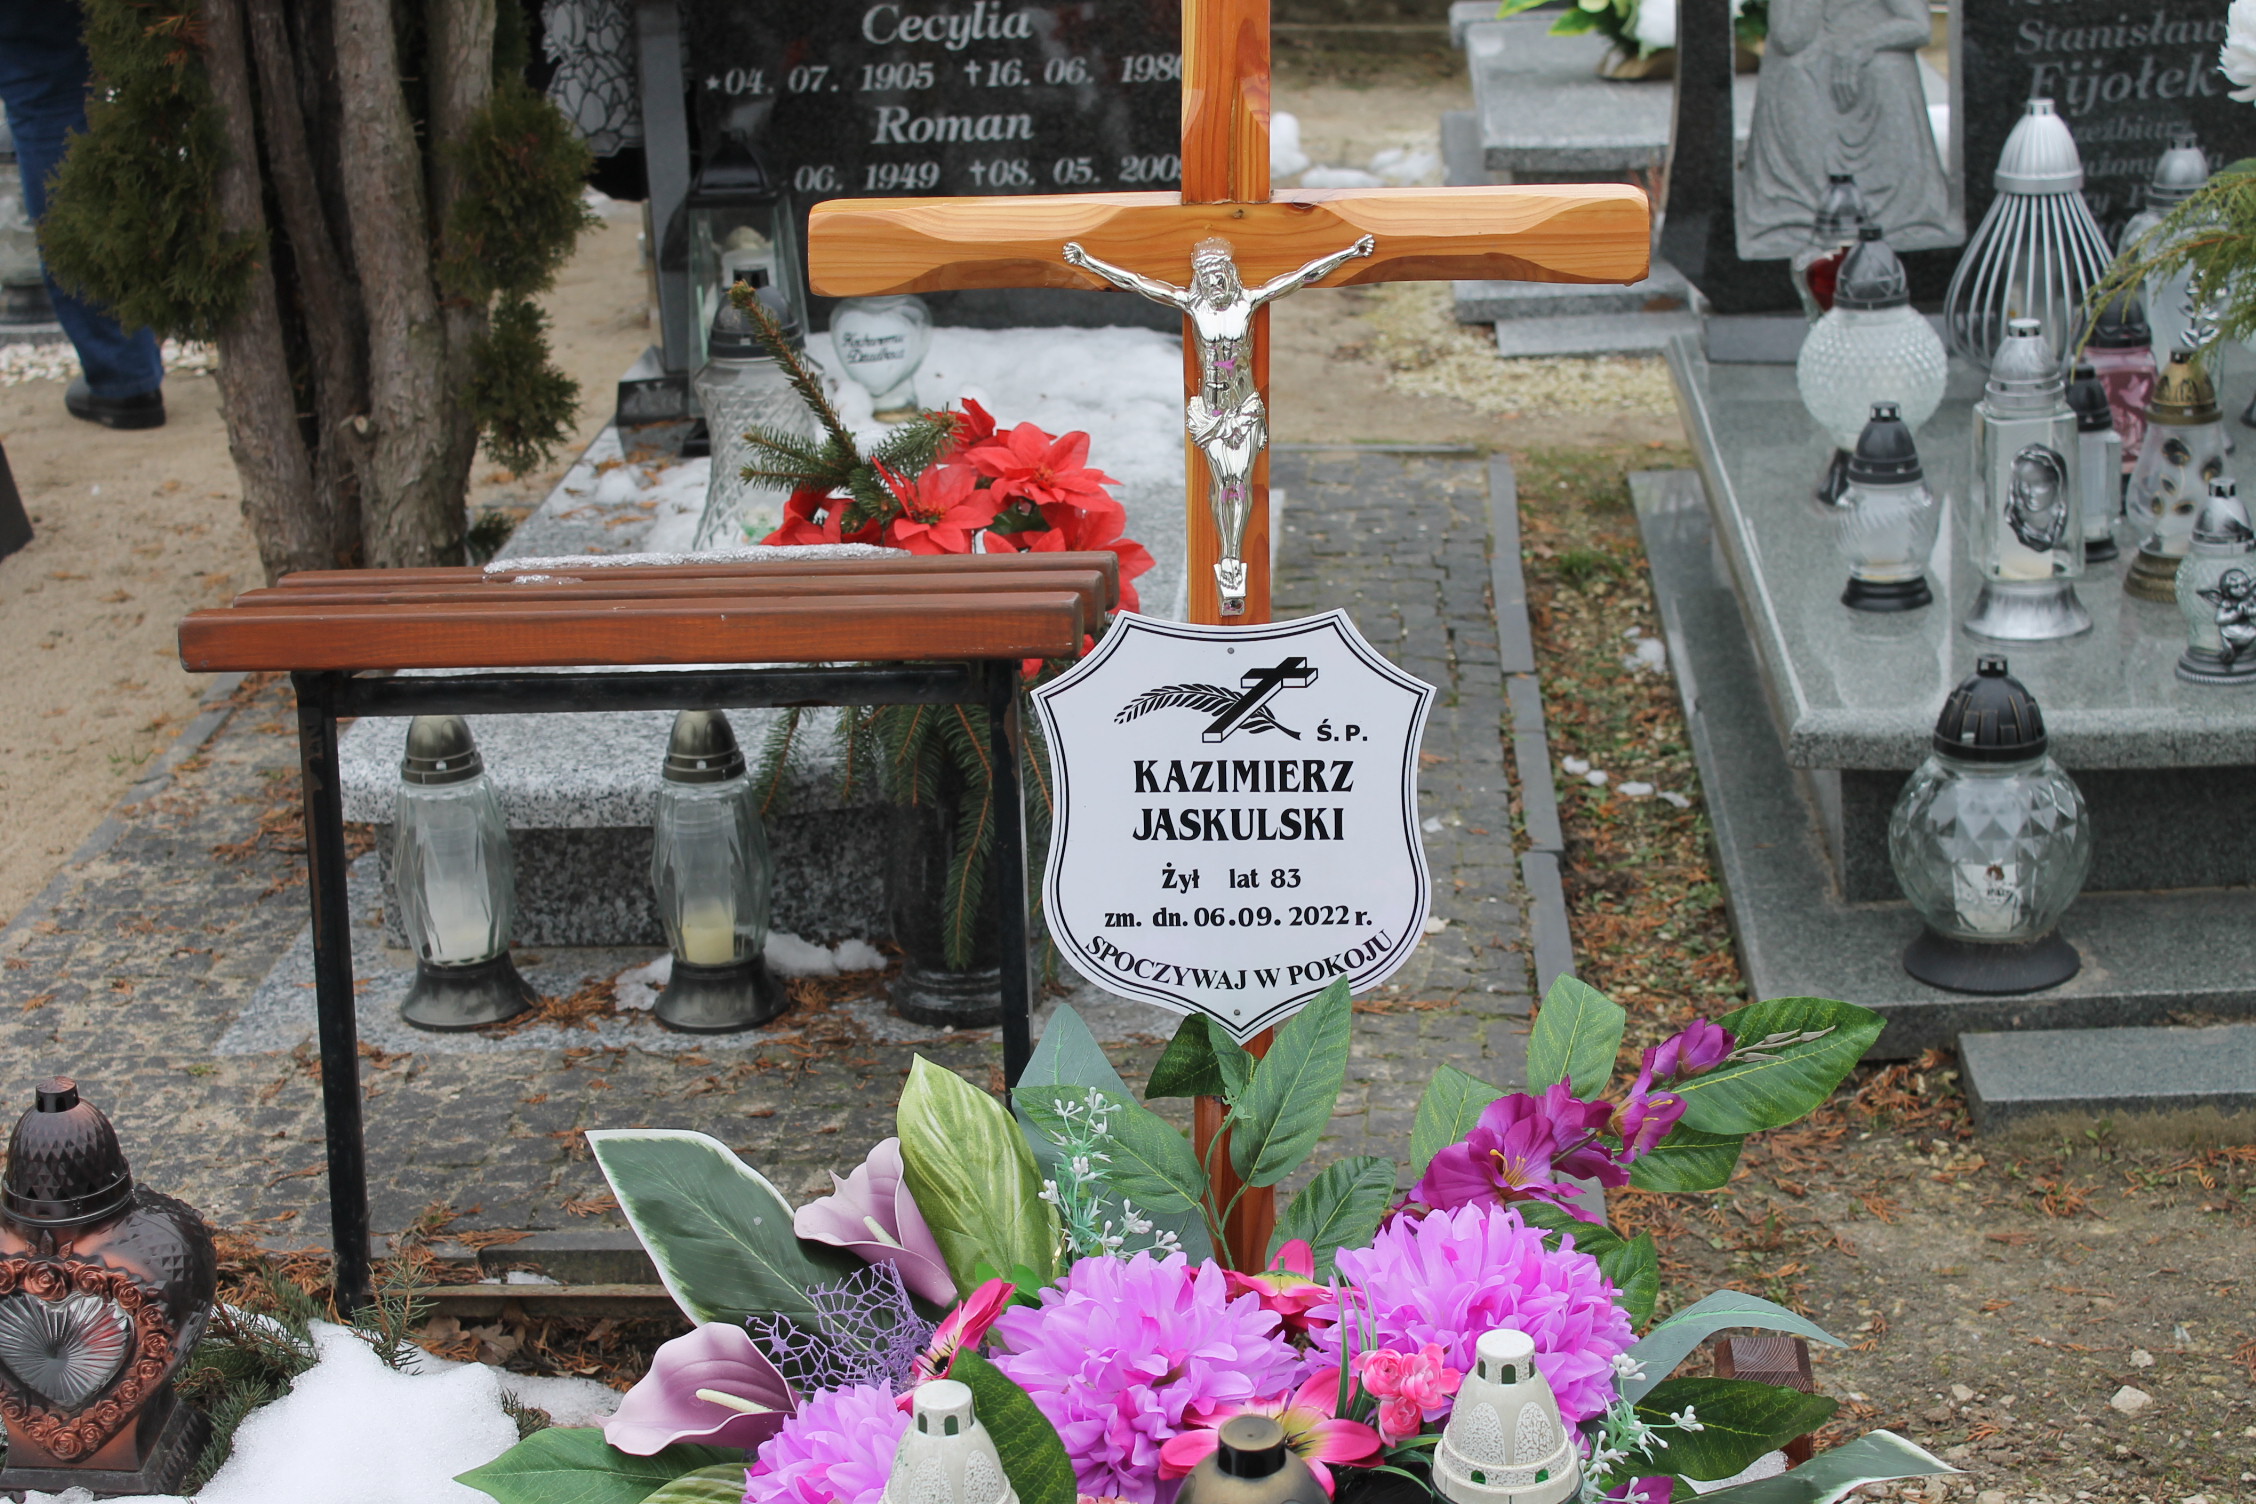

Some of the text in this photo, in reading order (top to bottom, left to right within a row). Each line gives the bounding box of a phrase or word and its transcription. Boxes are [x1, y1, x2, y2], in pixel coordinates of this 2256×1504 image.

[862, 3, 1033, 51] Cecylia
[788, 65, 839, 93] 07.
[860, 62, 935, 92] 1905
[1044, 57, 1094, 85] 06.
[2030, 53, 2218, 116] Fijołek
[871, 106, 1036, 144] Roman
[794, 165, 843, 192] 06.
[863, 161, 940, 191] 1949
[1053, 157, 1101, 185] 05.
[1118, 153, 1182, 183] 200
[1133, 759, 1354, 793] KAZIMIERZ
[1132, 807, 1344, 842] JASKULSKI
[1161, 861, 1302, 895] Żył lat 83
[1104, 912, 1142, 928] zm.
[1085, 929, 1393, 990] SPOCZYWAJ W POKOJU
